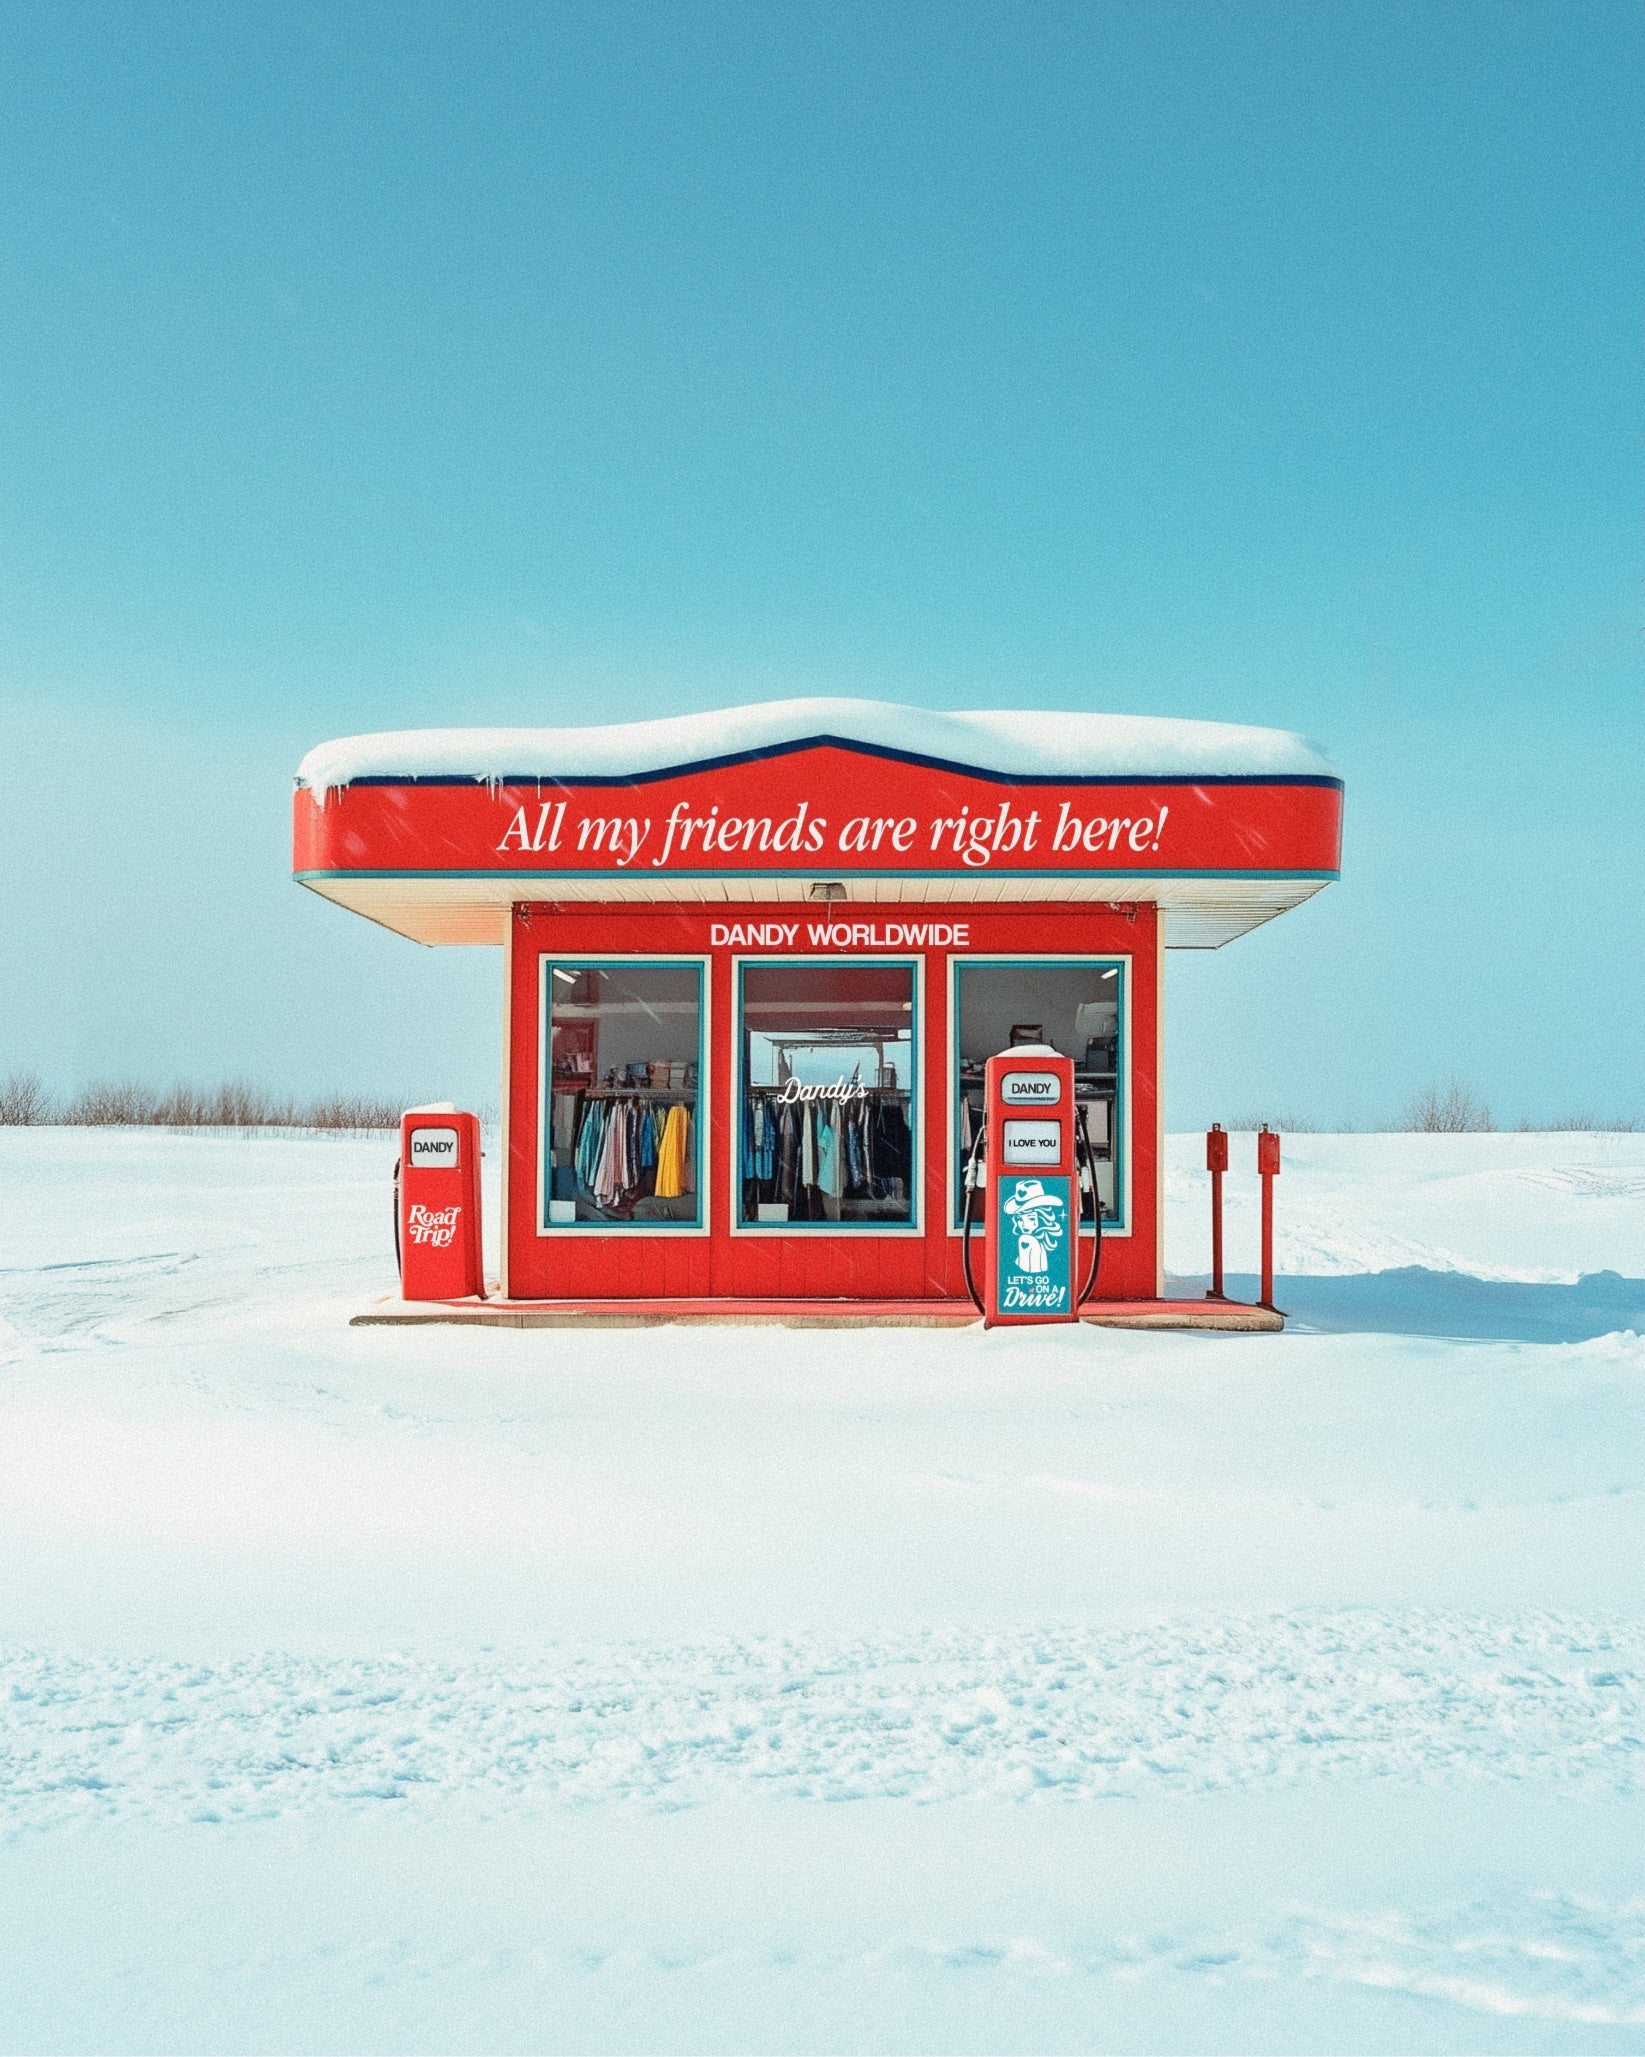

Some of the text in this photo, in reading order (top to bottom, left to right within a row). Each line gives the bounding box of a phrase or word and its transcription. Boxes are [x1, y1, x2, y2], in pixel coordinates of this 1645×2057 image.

[496, 801, 1169, 867] All my friends are right here!
[710, 923, 970, 947] DANDY WORLDWIDE
[777, 1074, 869, 1106] Dandy's
[1011, 1083, 1051, 1094] DANDY
[414, 1142, 454, 1153] DANDY
[1013, 1139, 1036, 1147] LOVE
[1038, 1139, 1056, 1147] YOU
[408, 1204, 462, 1227] Road
[409, 1224, 457, 1248] Trip!
[1007, 1276, 1049, 1285] LET'S GO
[1035, 1285, 1059, 1294] ON A
[1003, 1286, 1066, 1308] Drive!
